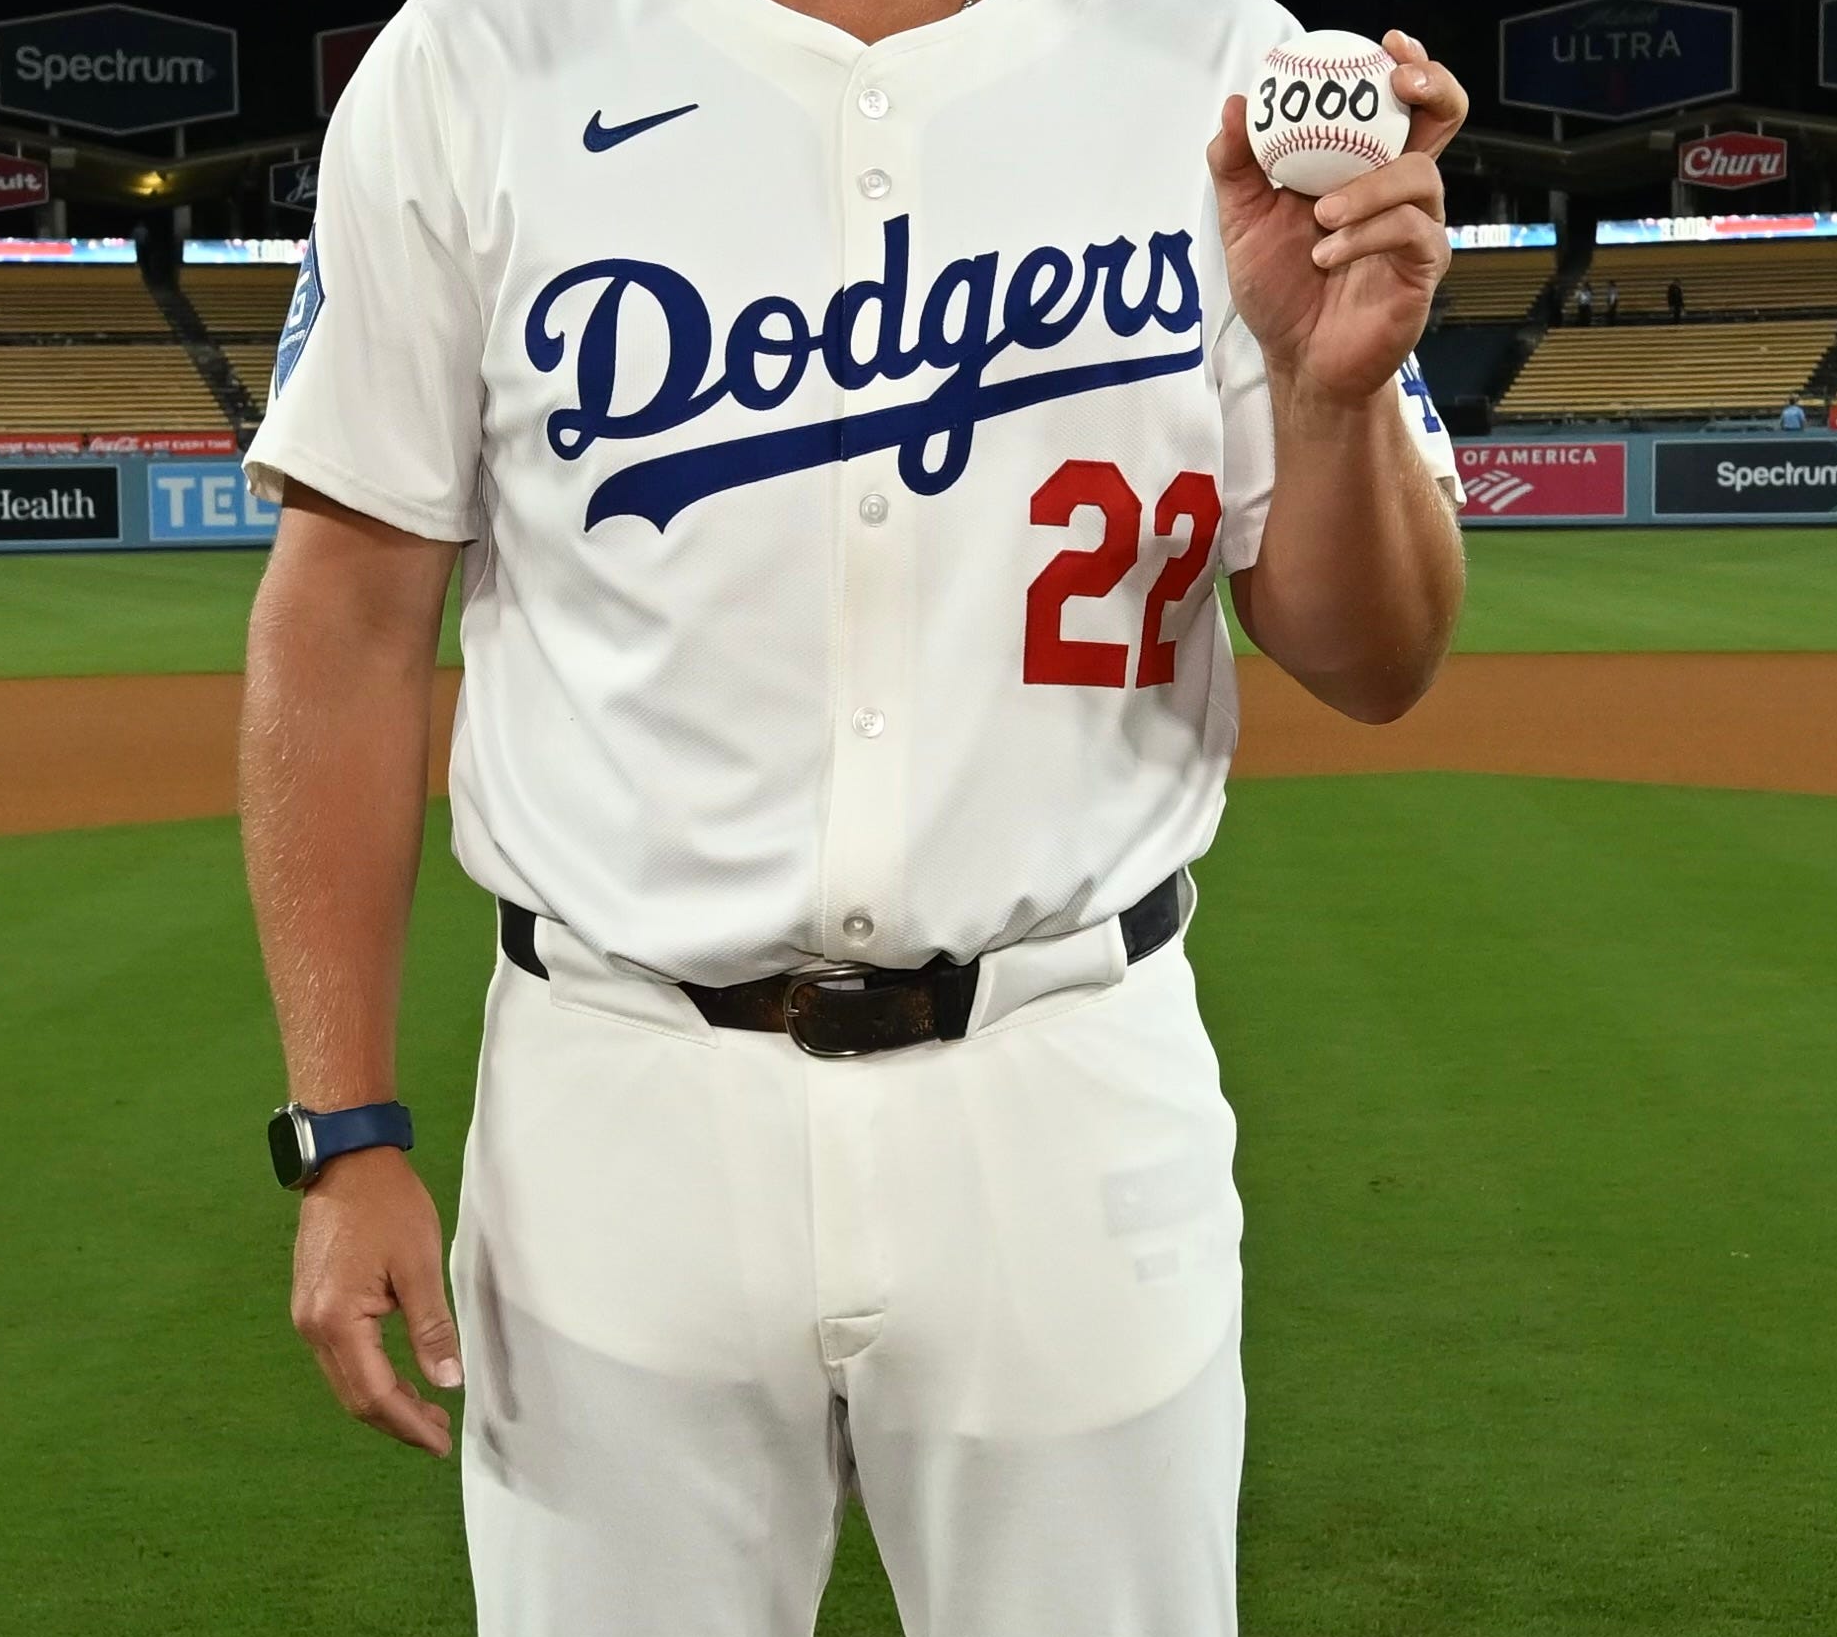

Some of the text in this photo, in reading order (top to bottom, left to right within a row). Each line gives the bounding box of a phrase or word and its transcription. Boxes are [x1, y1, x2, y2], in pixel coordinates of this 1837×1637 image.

[15, 45, 205, 91] Spectrum
[1553, 29, 1682, 63] ULTRA
[1254, 77, 1379, 132] 3000
[1683, 145, 1781, 178] Churu
[524, 214, 1204, 536] Dodgers
[1463, 448, 1597, 466] OF AMERICA
[157, 476, 276, 527] TEL
[1021, 458, 1221, 690] 22
